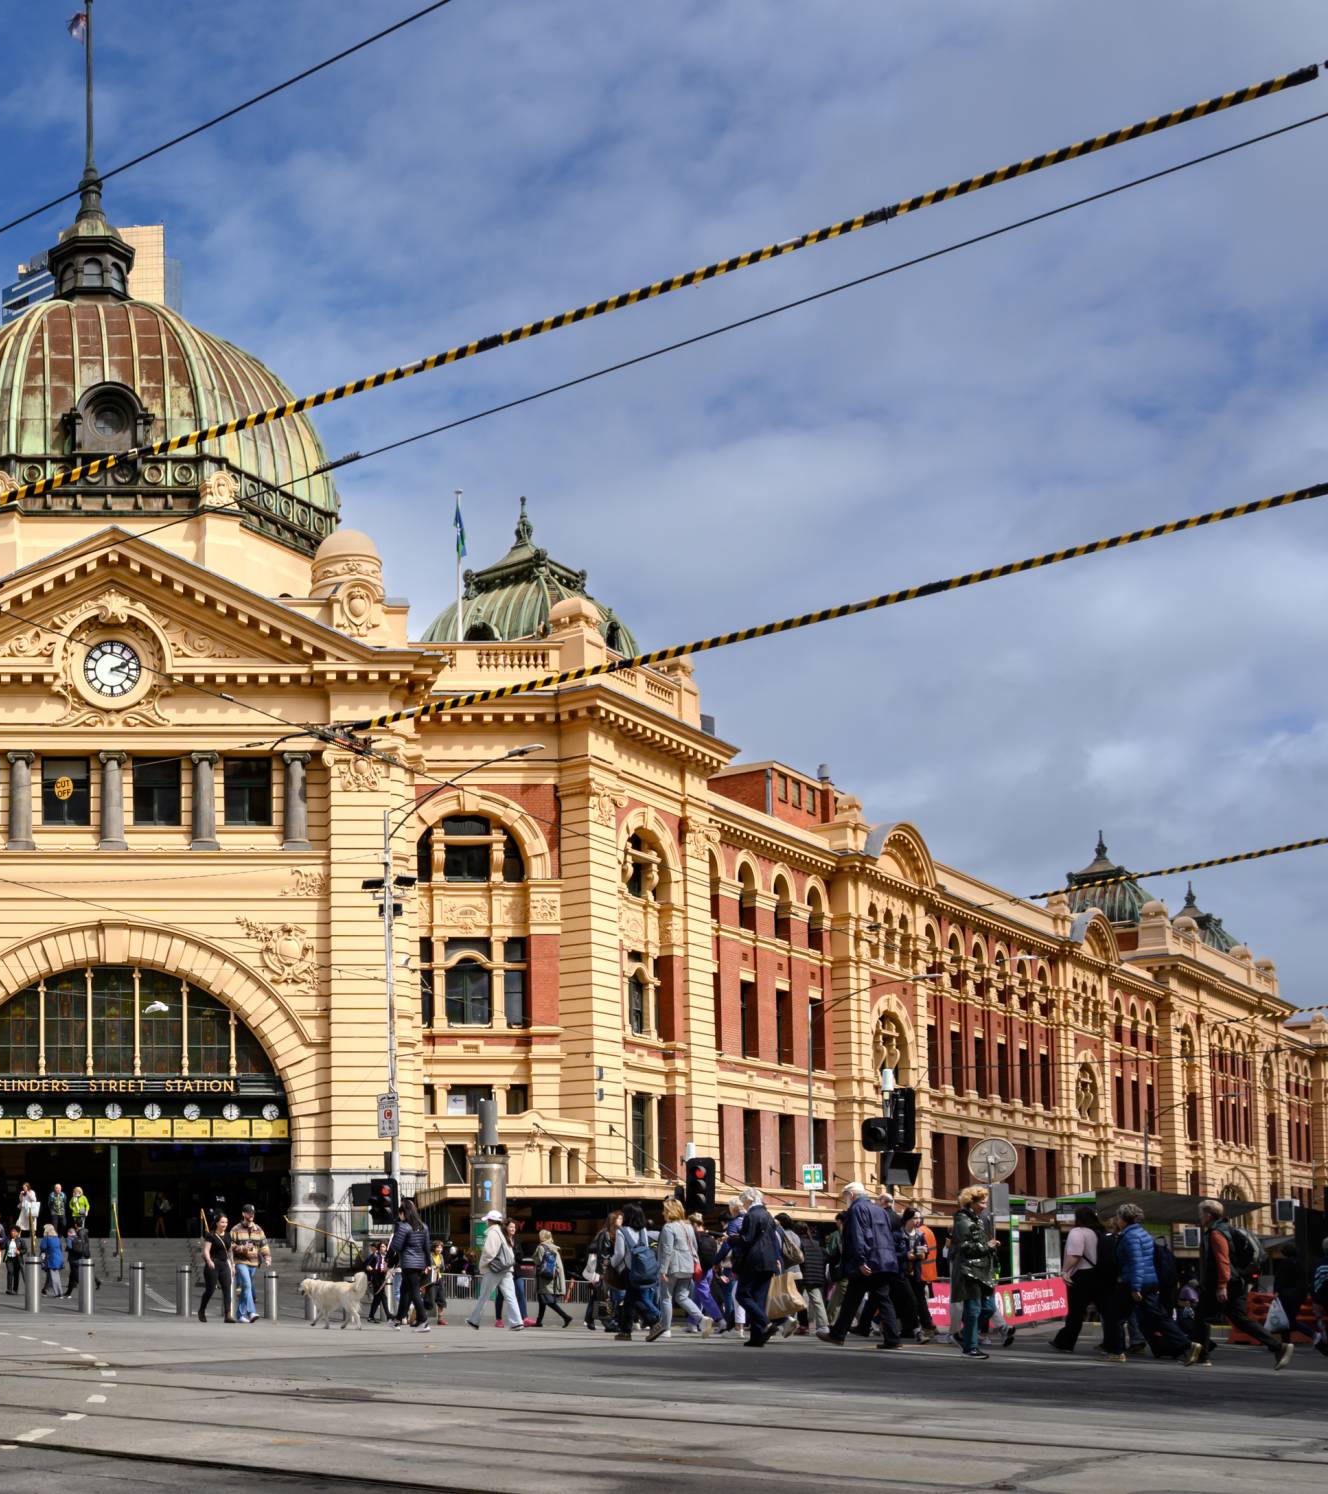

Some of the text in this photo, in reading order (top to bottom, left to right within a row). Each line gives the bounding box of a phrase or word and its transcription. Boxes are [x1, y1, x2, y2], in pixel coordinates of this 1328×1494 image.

[56, 779, 71, 788] CUT
[57, 789, 71, 798] OFF
[89, 1079, 146, 1092] STREET
[164, 1079, 235, 1092] STATION
